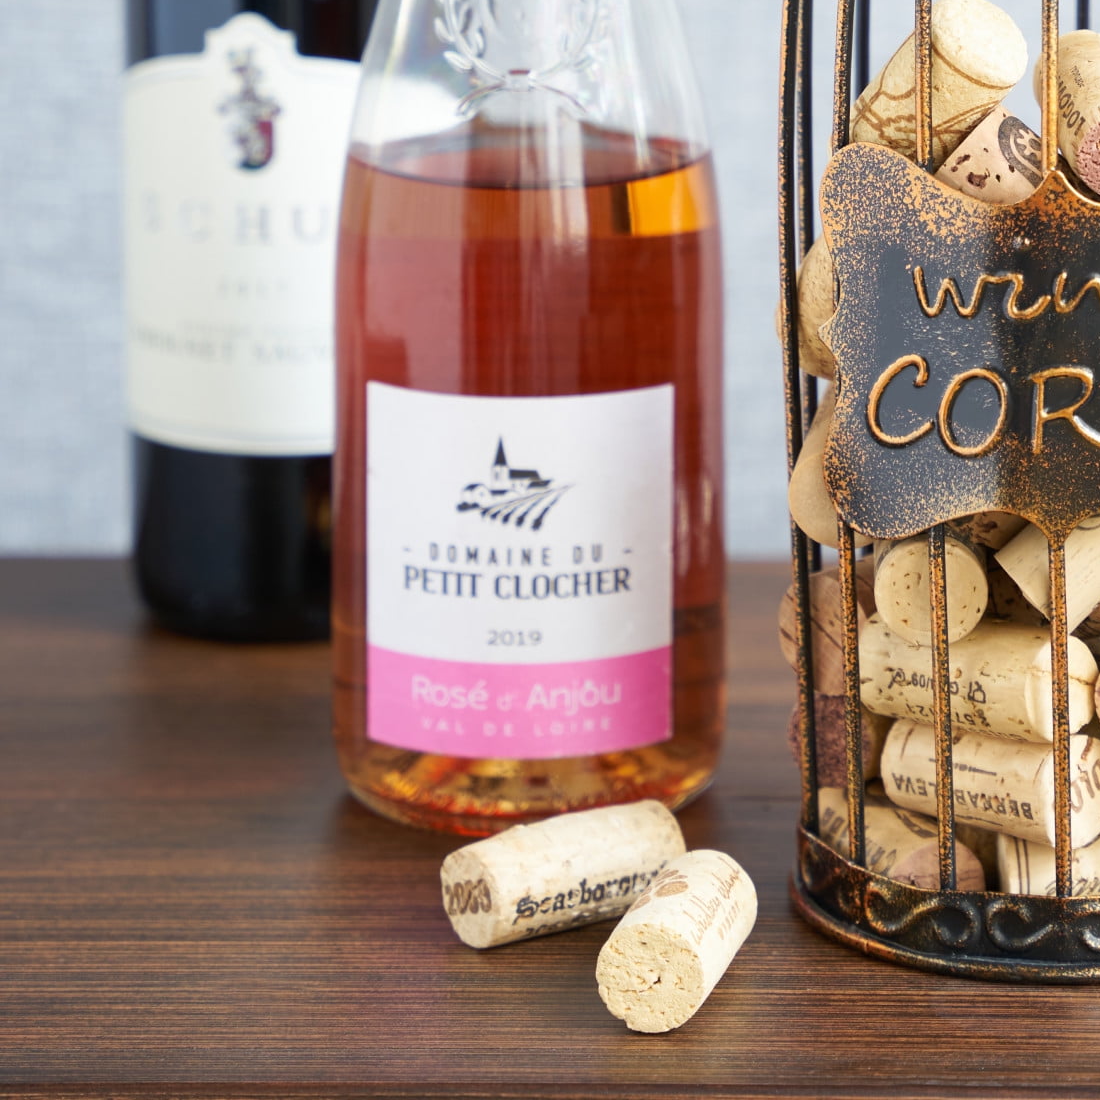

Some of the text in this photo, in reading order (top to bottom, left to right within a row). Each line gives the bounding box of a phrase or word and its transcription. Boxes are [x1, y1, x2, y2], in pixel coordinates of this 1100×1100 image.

[429, 542, 604, 566] DOMAINE DU
[404, 565, 631, 600] PETIT CLOCHER
[487, 630, 543, 647] 2019
[411, 674, 488, 710] Rosé
[422, 716, 613, 738] VAL DE LOIRE
[891, 772, 1034, 820] BERNABLEVA
